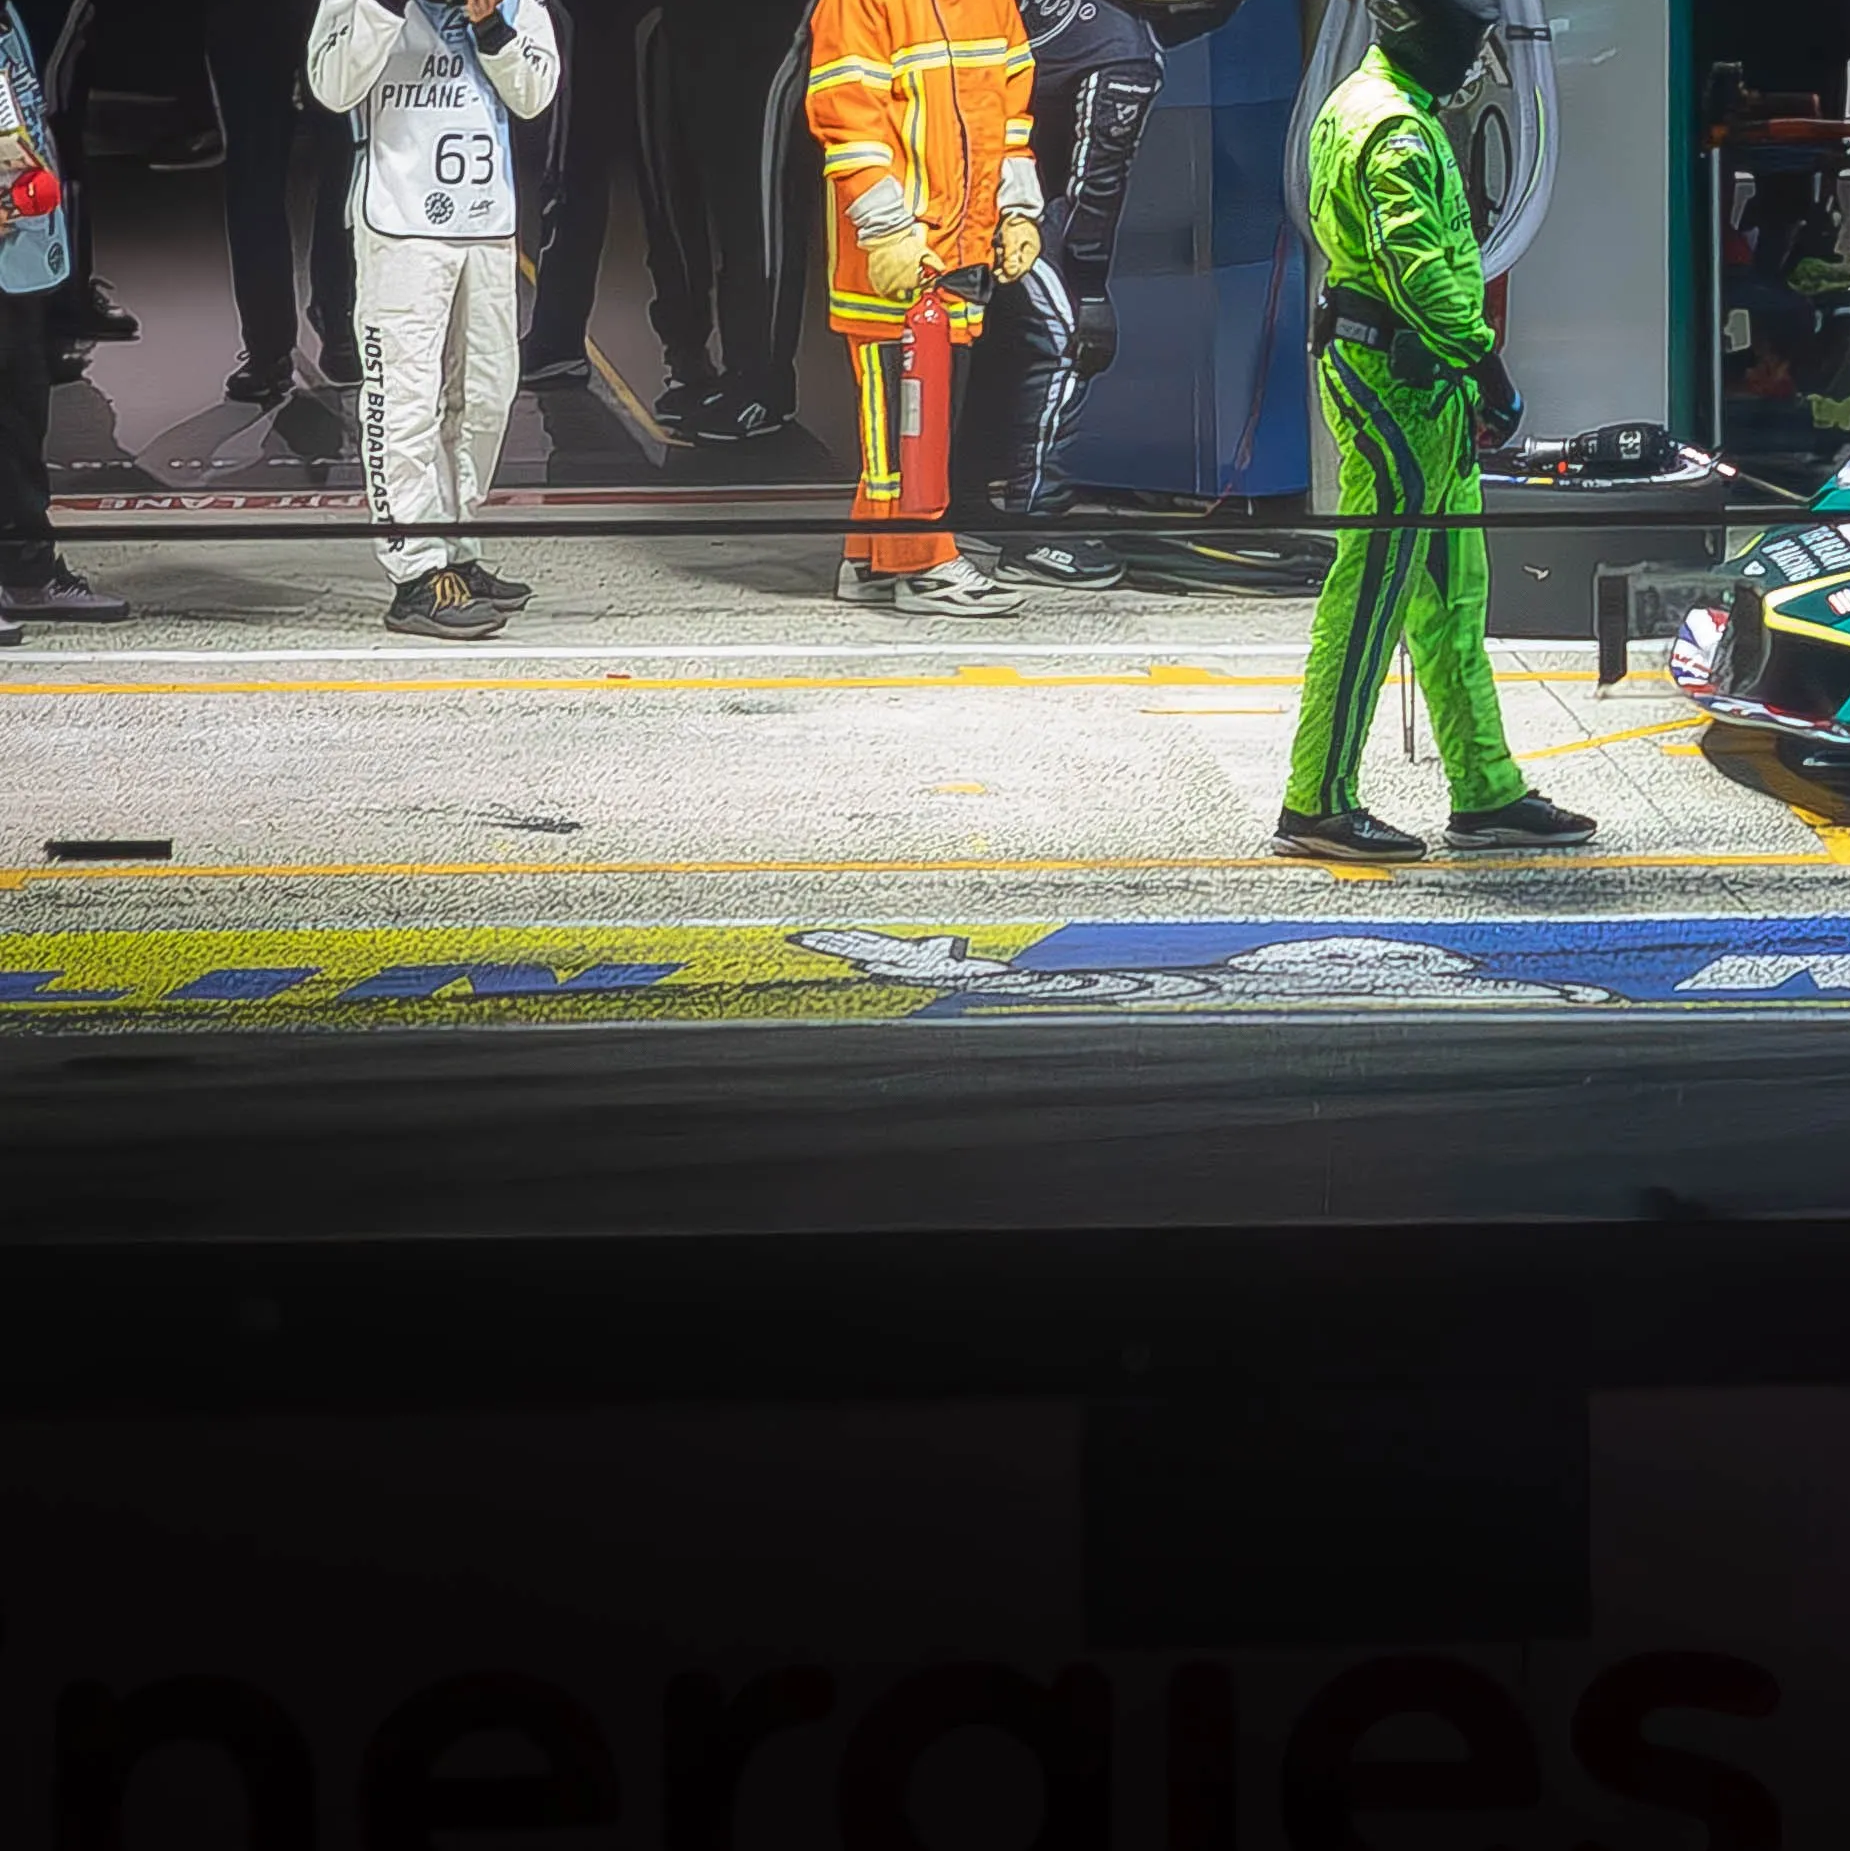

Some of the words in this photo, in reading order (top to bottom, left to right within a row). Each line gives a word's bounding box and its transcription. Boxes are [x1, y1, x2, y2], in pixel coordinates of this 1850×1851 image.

[381, 83, 468, 109] PITLANE
[435, 133, 494, 185] 63
[364, 324, 384, 390] HOST
[366, 391, 406, 554] BROADCASTR
